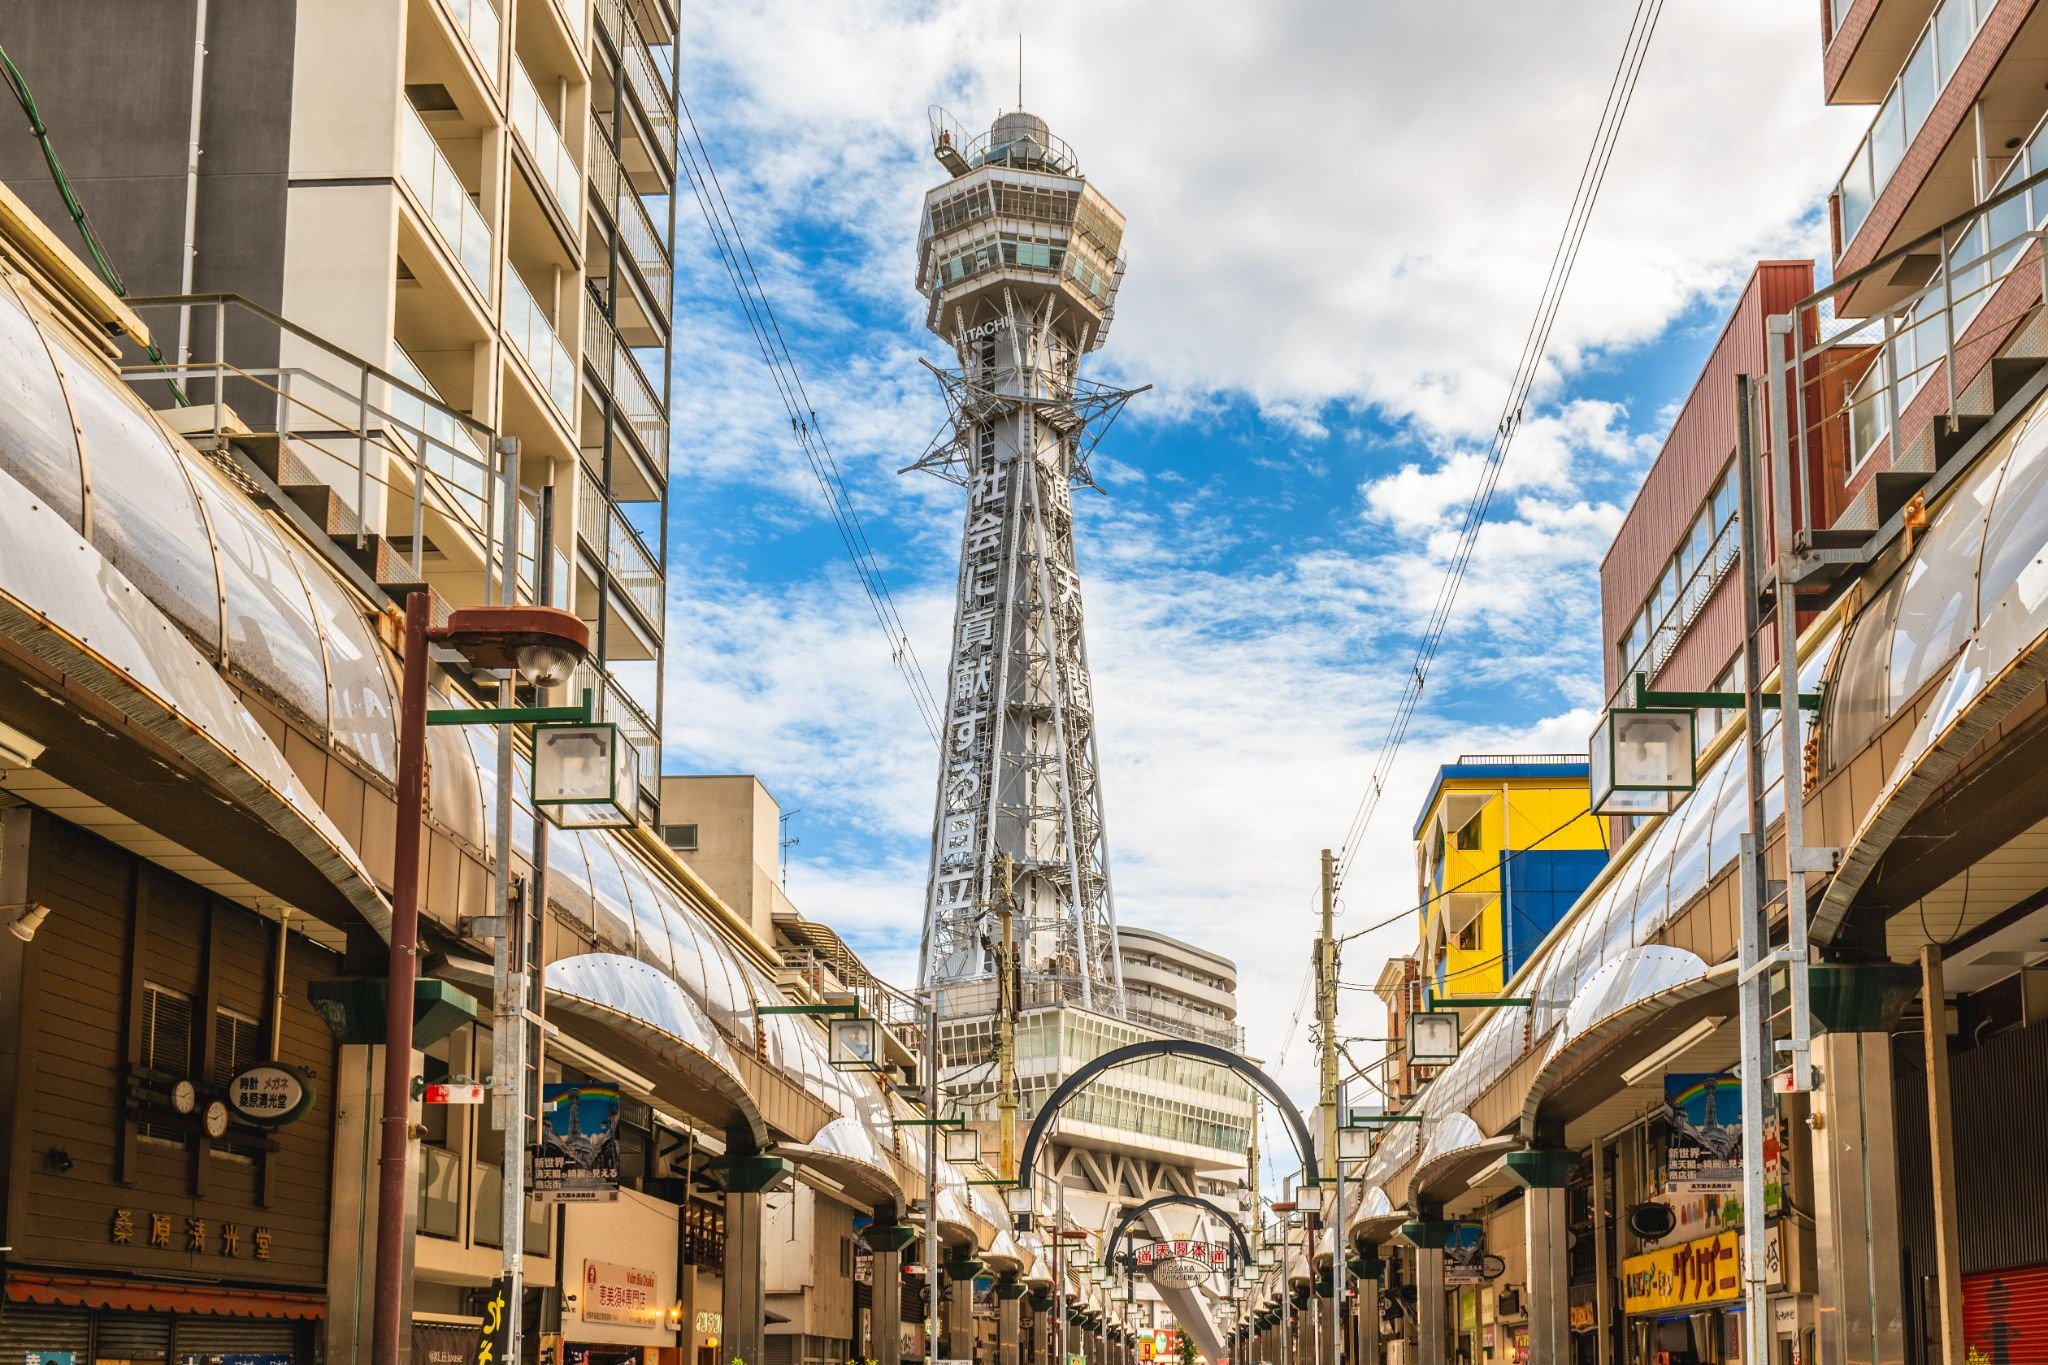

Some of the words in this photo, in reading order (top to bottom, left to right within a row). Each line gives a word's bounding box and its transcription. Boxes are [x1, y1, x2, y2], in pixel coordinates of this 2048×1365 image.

[952, 316, 1010, 347] HITACHI
[263, 1077, 289, 1090] メガネ
[1137, 1240, 1226, 1265] 通天閣本通
